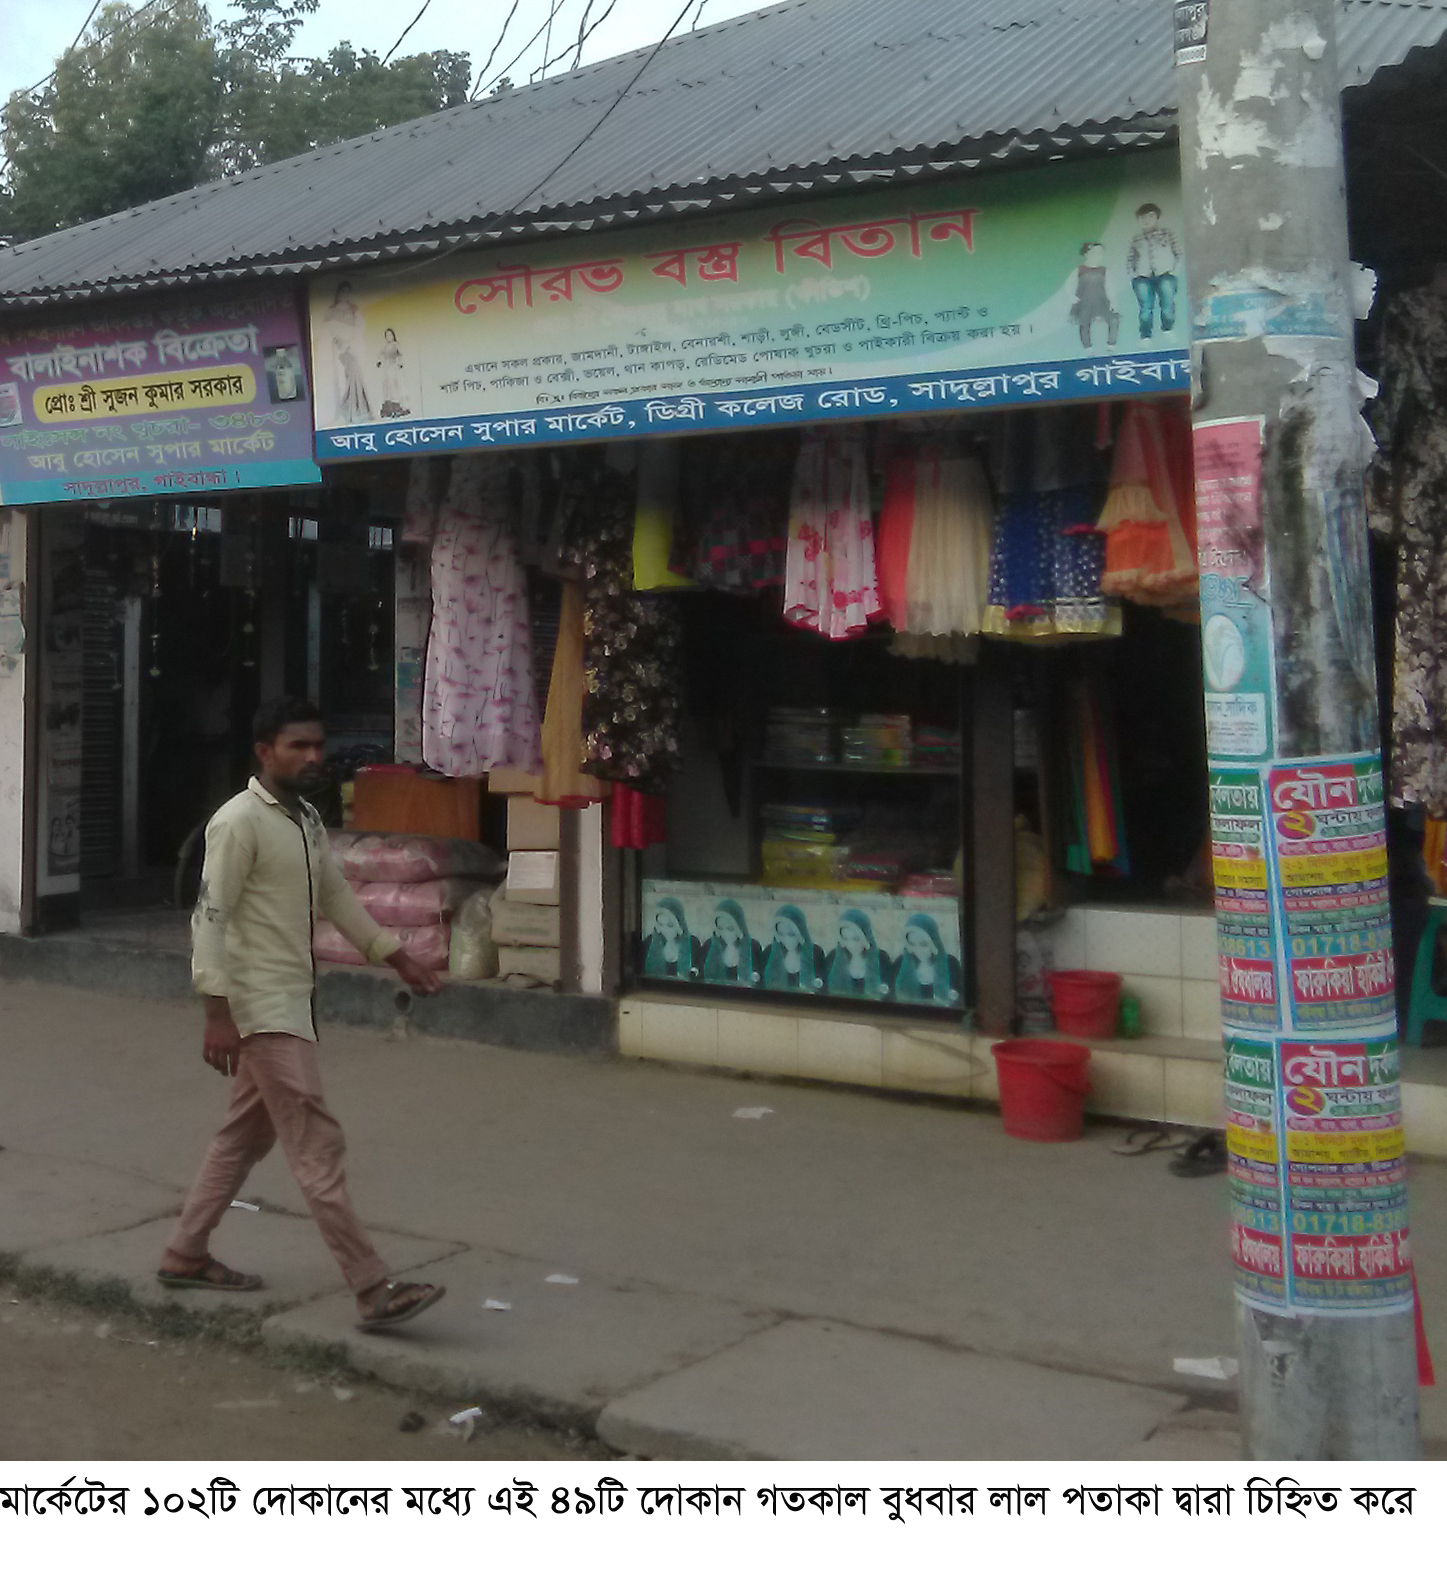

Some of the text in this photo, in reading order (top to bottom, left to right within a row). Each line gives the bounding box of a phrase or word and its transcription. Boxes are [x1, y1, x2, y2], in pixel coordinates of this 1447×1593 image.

[453, 257, 625, 316] সৌরভ
[645, 240, 745, 288] বস্ত্র
[763, 206, 982, 276] বিতান
[6, 322, 261, 382] বালাইনাশক বিক্রেতা
[502, 357, 528, 370] সকল
[45, 374, 244, 415] প্রোঃ শ্রী সুজন কুমার সরকার
[331, 432, 378, 452] আবু
[384, 421, 465, 446] হোসেন
[471, 417, 537, 443] সুপার
[545, 404, 636, 432] মার্কেট,
[646, 393, 705, 424] ডিগ্রী
[714, 391, 805, 418] কলেজ
[818, 383, 899, 410] রোড,
[907, 369, 1062, 403] সাদুল্লাপুর
[27, 429, 277, 474] আবু হোসেন সুপার মার্কেট
[1273, 768, 1355, 811] যৌন
[1284, 1045, 1367, 1087] যৌন
